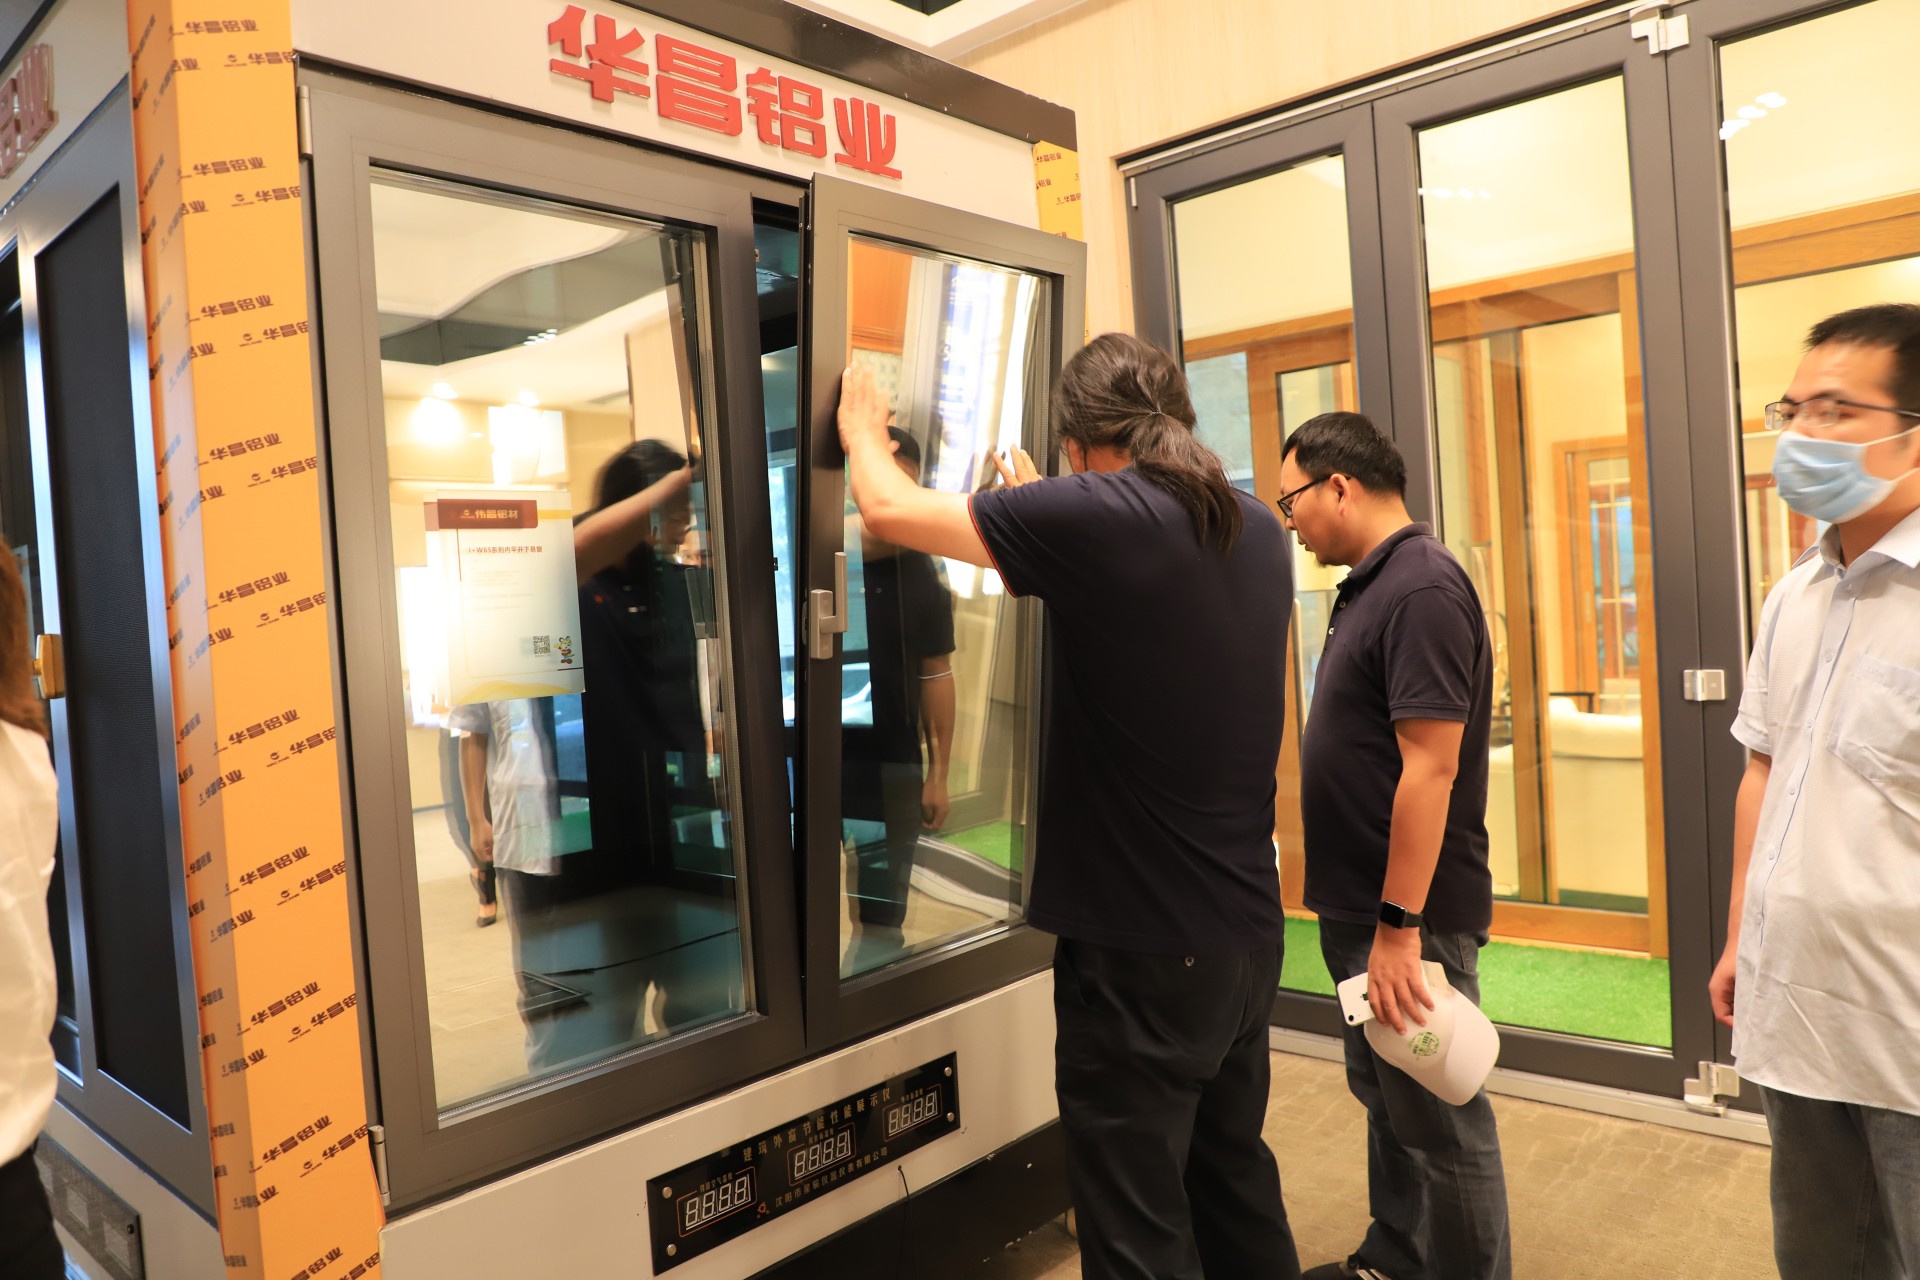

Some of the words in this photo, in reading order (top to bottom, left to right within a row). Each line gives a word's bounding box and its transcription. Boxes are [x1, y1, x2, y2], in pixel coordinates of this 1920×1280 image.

[185, 19, 259, 34] 华昌铝业
[548, 5, 902, 180] 华昌铝业
[193, 156, 266, 178] 华昌铝业
[200, 294, 274, 320] 华昌铝业
[209, 432, 283, 461] 华昌铝业
[218, 571, 291, 604] 华昌铝业
[228, 709, 301, 746] 华昌铝业
[239, 845, 311, 886] 华昌铝业
[250, 982, 321, 1026] 华昌铝业
[262, 1115, 332, 1163] 华昌铝业
